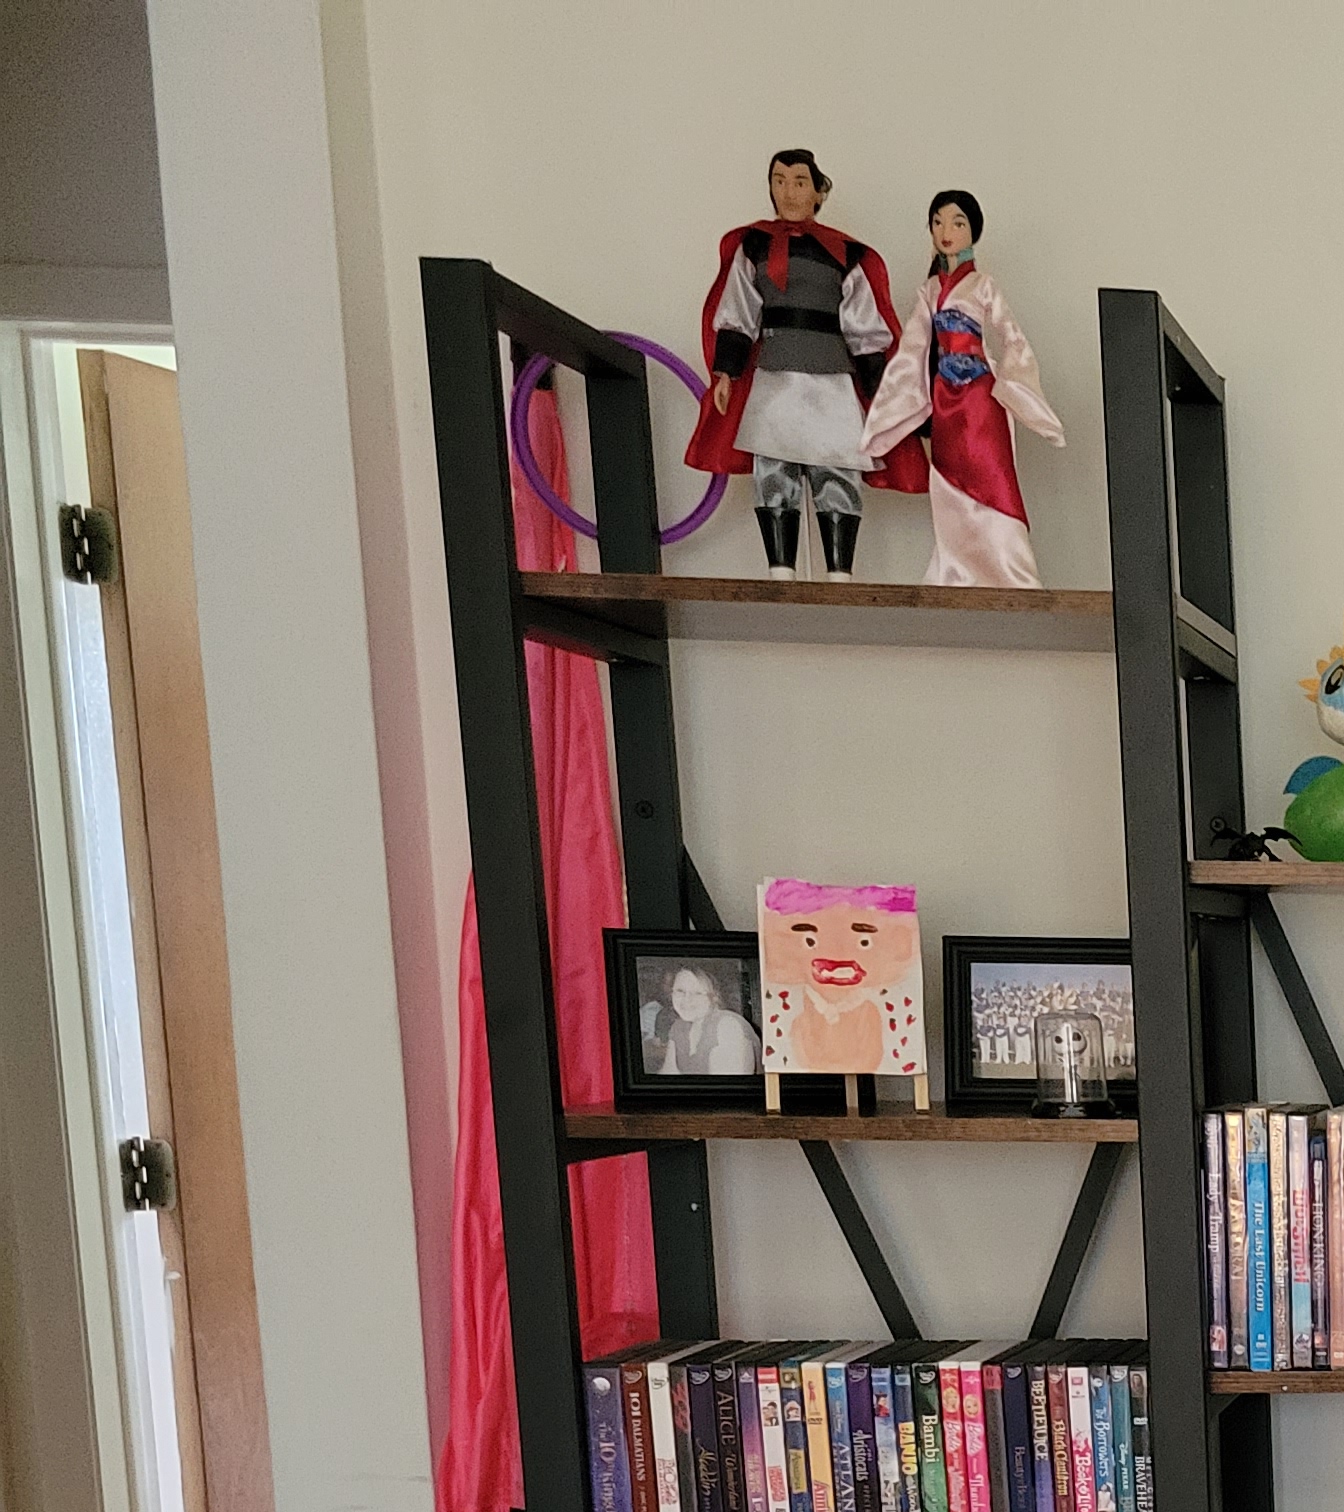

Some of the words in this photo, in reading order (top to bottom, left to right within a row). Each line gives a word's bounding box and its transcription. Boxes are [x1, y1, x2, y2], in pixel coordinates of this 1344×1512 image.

[1254, 1201, 1265, 1219] The
[1254, 1233, 1266, 1257] Last
[1255, 1260, 1267, 1312] Unicorn
[631, 1419, 646, 1481] DALMATIANS
[922, 1415, 941, 1463] Bambi
